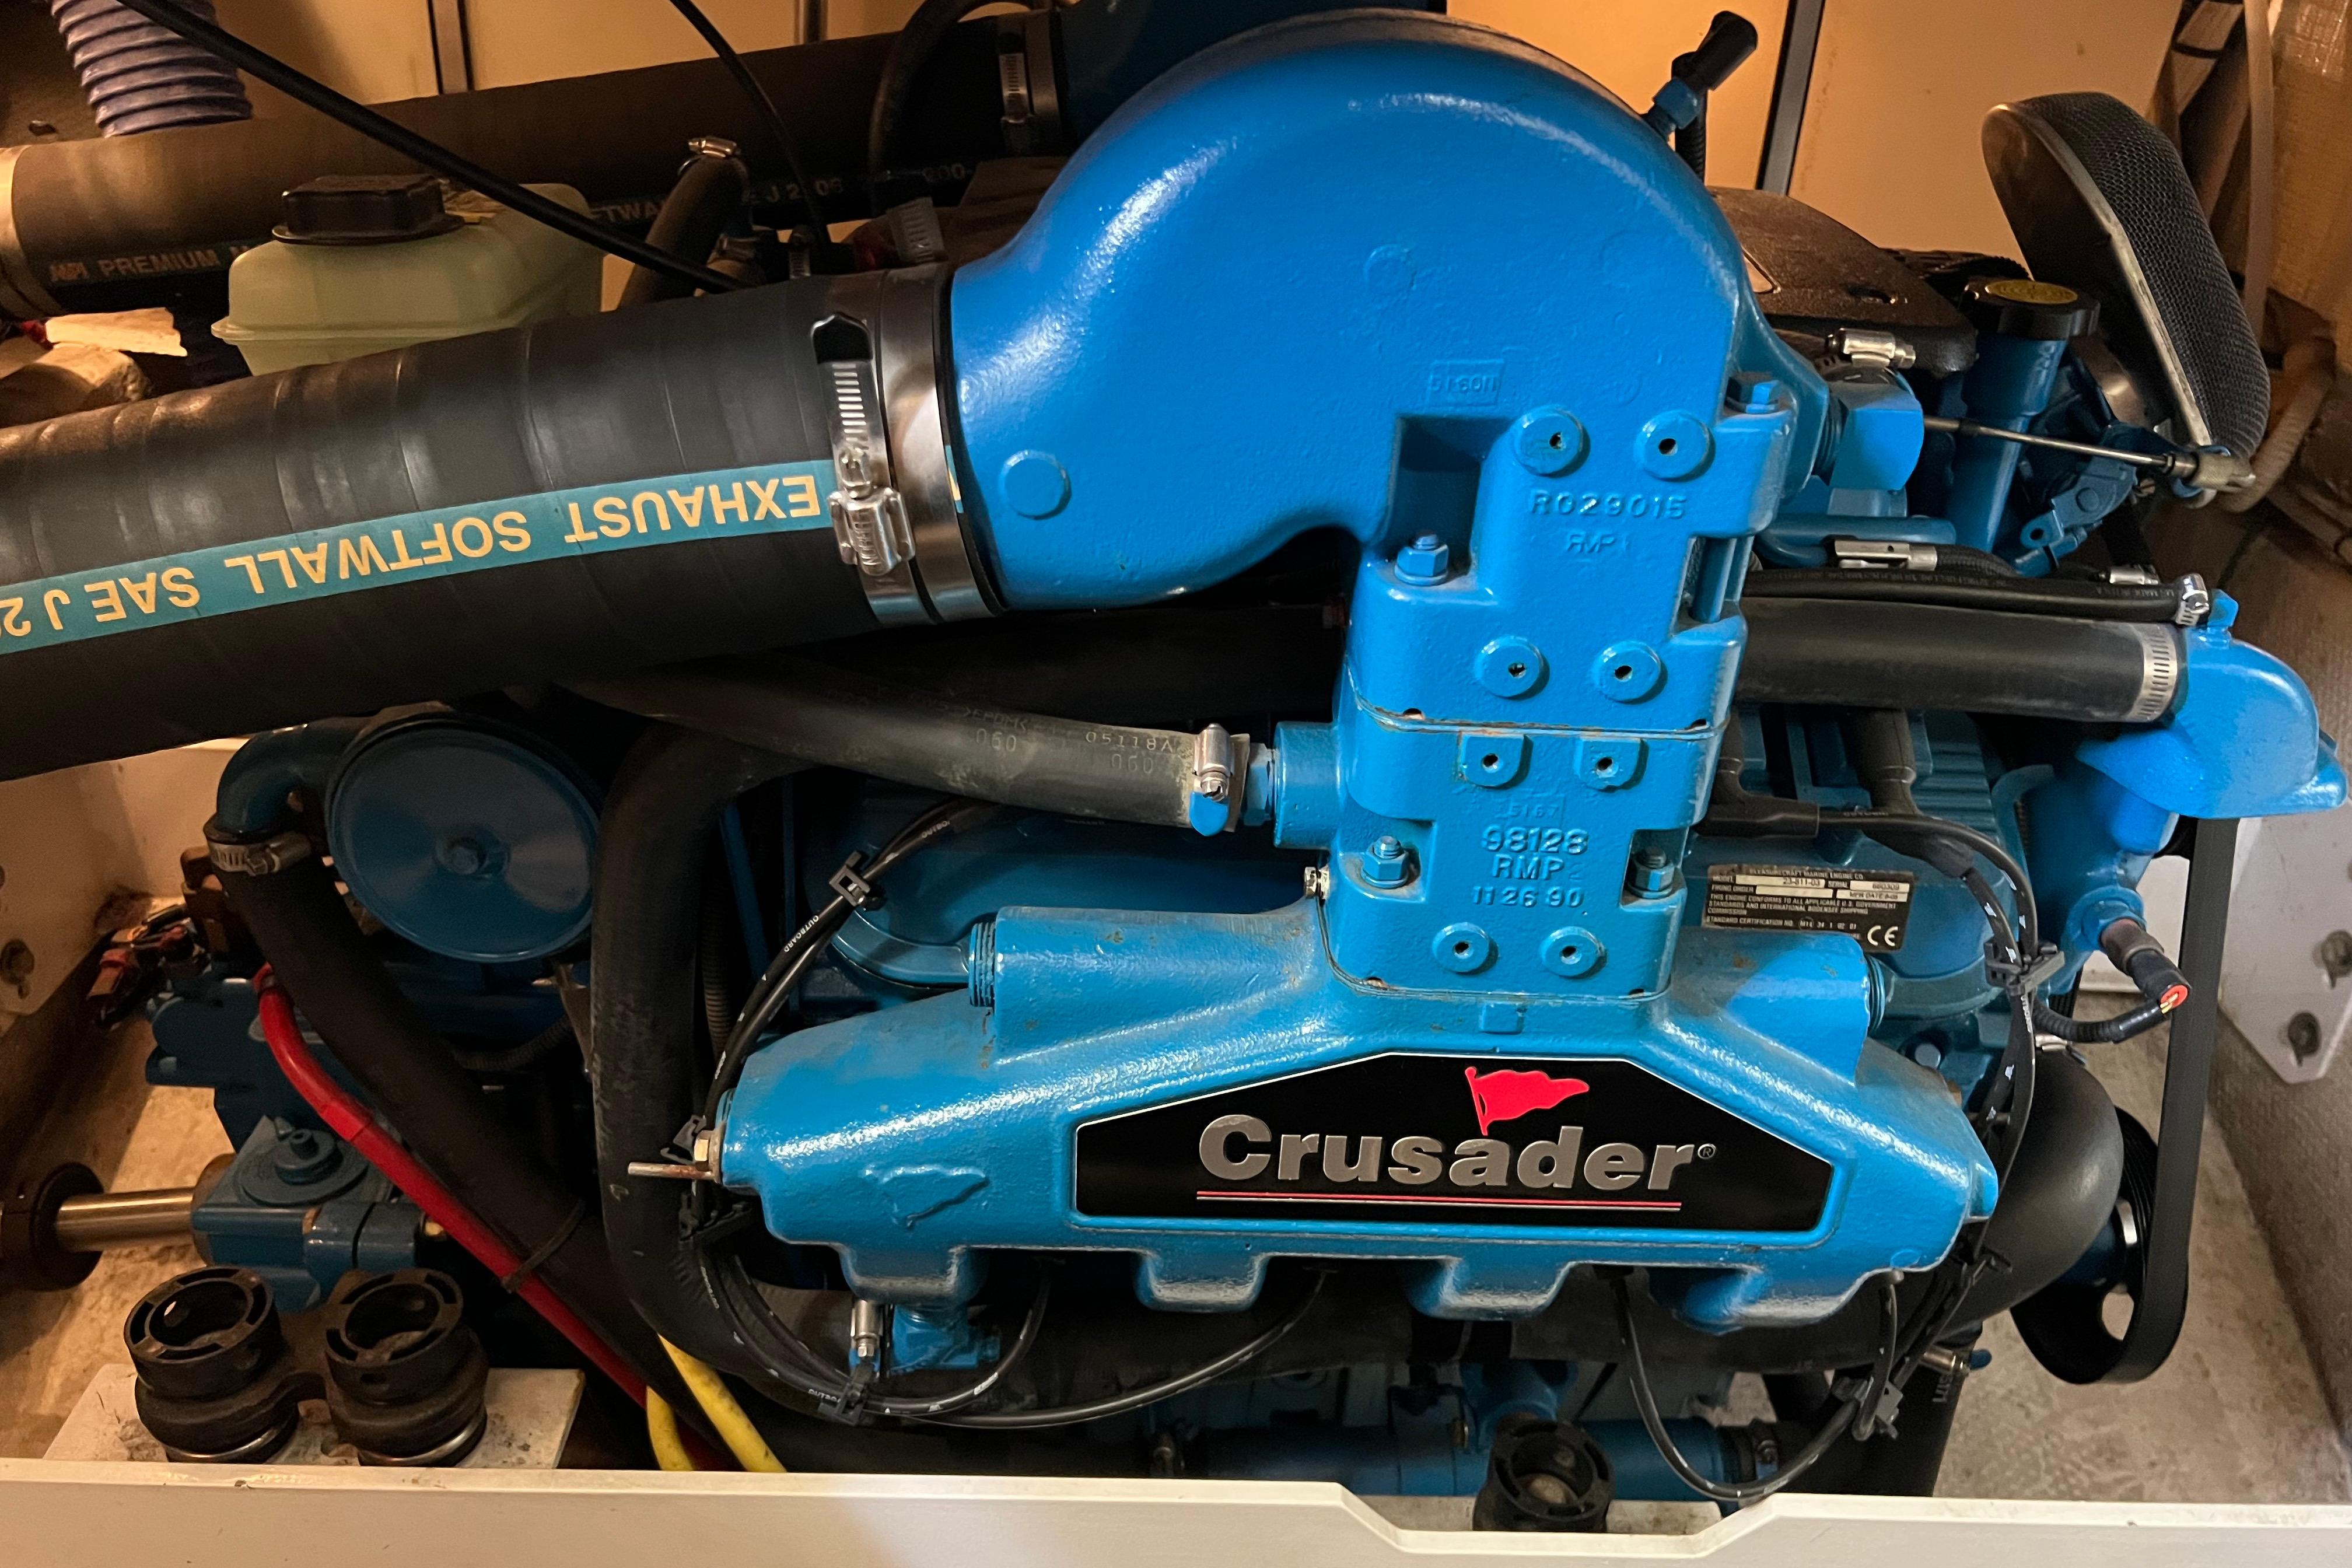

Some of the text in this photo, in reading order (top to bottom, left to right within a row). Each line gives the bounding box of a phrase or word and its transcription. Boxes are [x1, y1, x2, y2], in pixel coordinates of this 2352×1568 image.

[785, 178, 844, 201] 206
[97, 249, 222, 277] PREMIUM
[1530, 489, 1688, 520] R029015
[0, 474, 821, 636] EXHAUST SOFTWALL SAE J 2
[975, 728, 1017, 752] 060
[1085, 731, 1173, 753] 05118A
[1482, 824, 1589, 855] 98128
[1492, 853, 1565, 880] RMP
[1709, 900, 1745, 909] STANDARDS
[1759, 903, 1807, 912] INTERNATIONAL
[1748, 895, 1782, 904] CONFORMS
[1804, 898, 1840, 907] APPLICABLE
[1856, 901, 1896, 909] GOVERNMENT
[1706, 916, 1738, 924] STANDARD
[1739, 918, 1783, 926] CERTIFICATION
[783, 915, 820, 953] OUTBOARD
